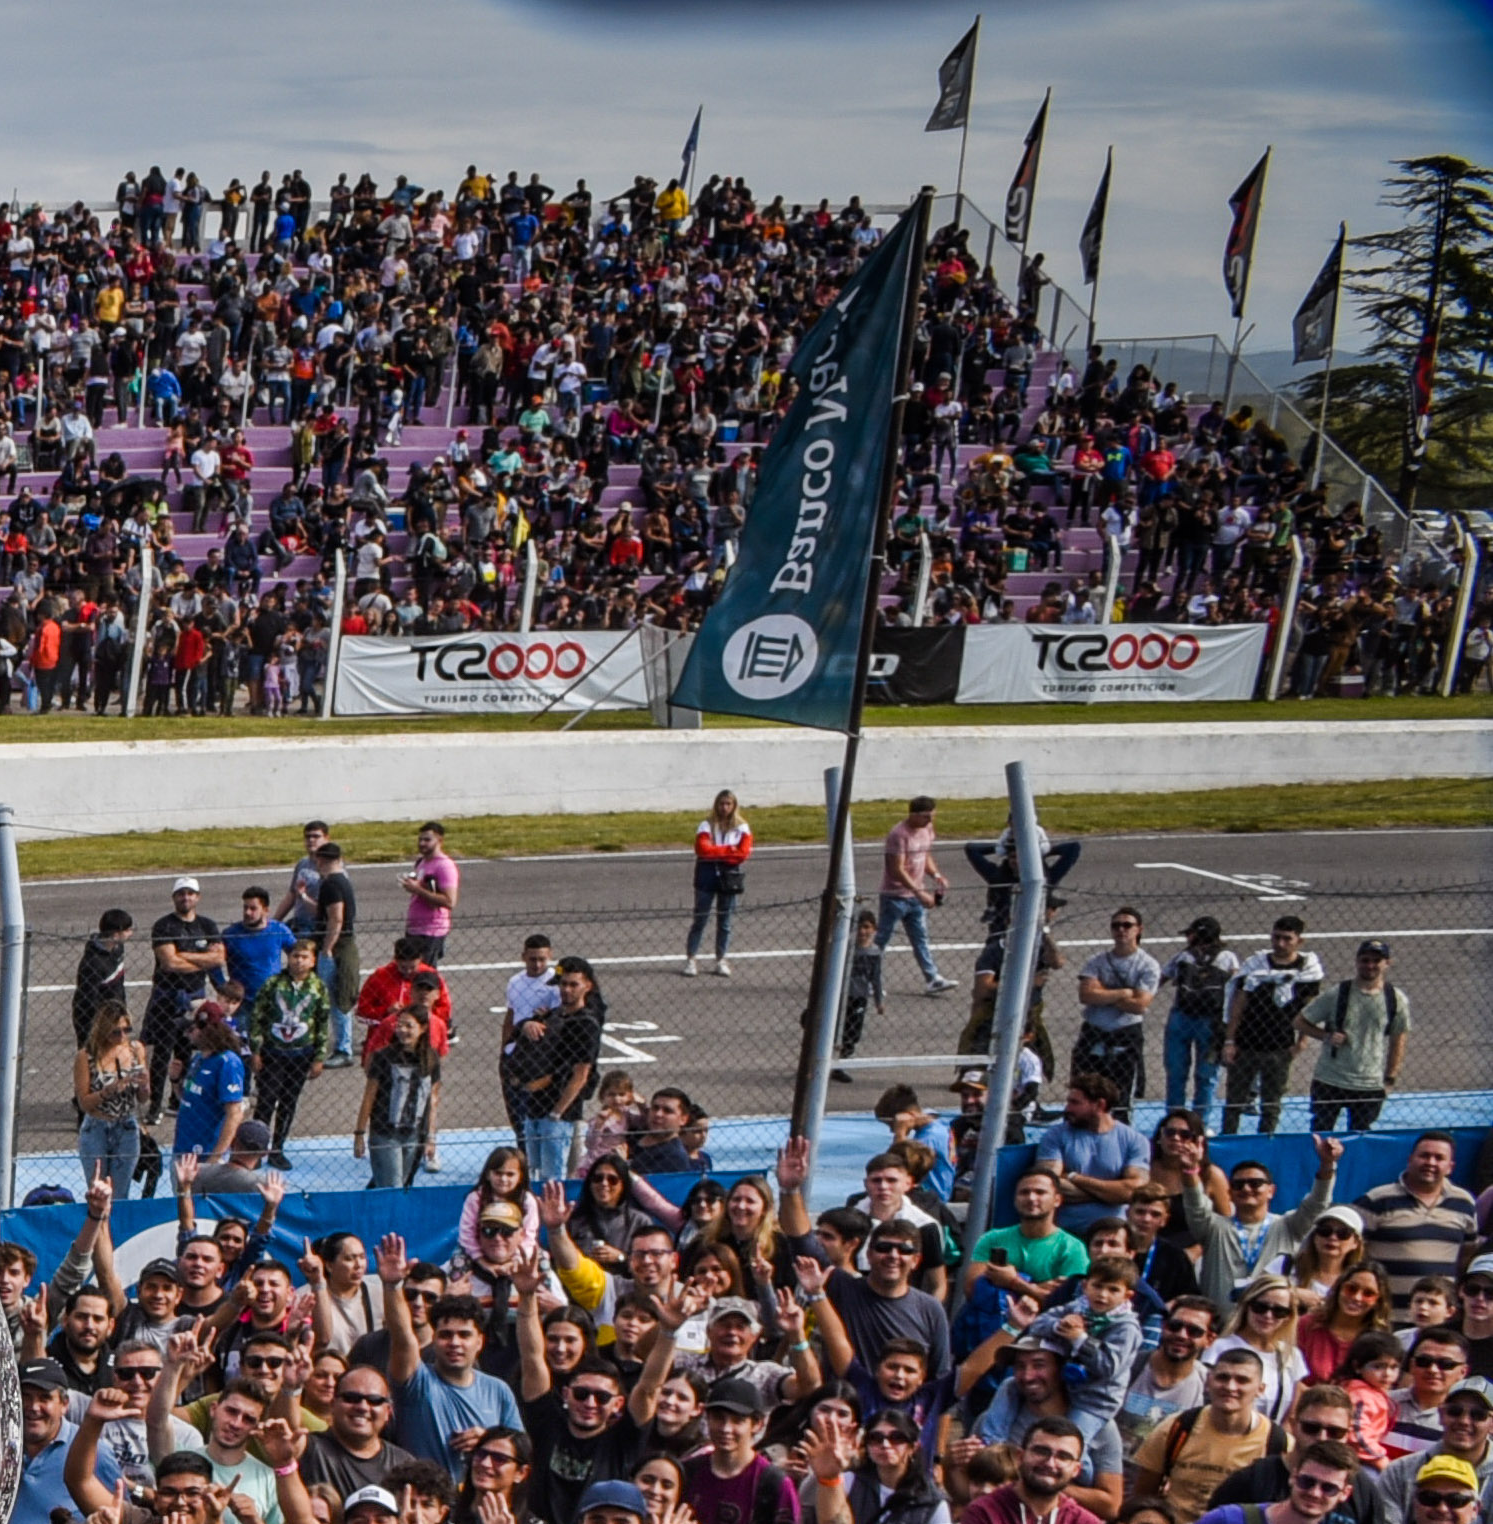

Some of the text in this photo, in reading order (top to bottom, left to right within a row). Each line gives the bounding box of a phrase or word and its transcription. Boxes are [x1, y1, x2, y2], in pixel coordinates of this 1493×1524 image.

[769, 438, 836, 595] Banco
[411, 641, 587, 682] TC2000
[1032, 632, 1201, 672] TC2000
[423, 694, 478, 704] TURISMO
[1042, 683, 1097, 695] TURISMO
